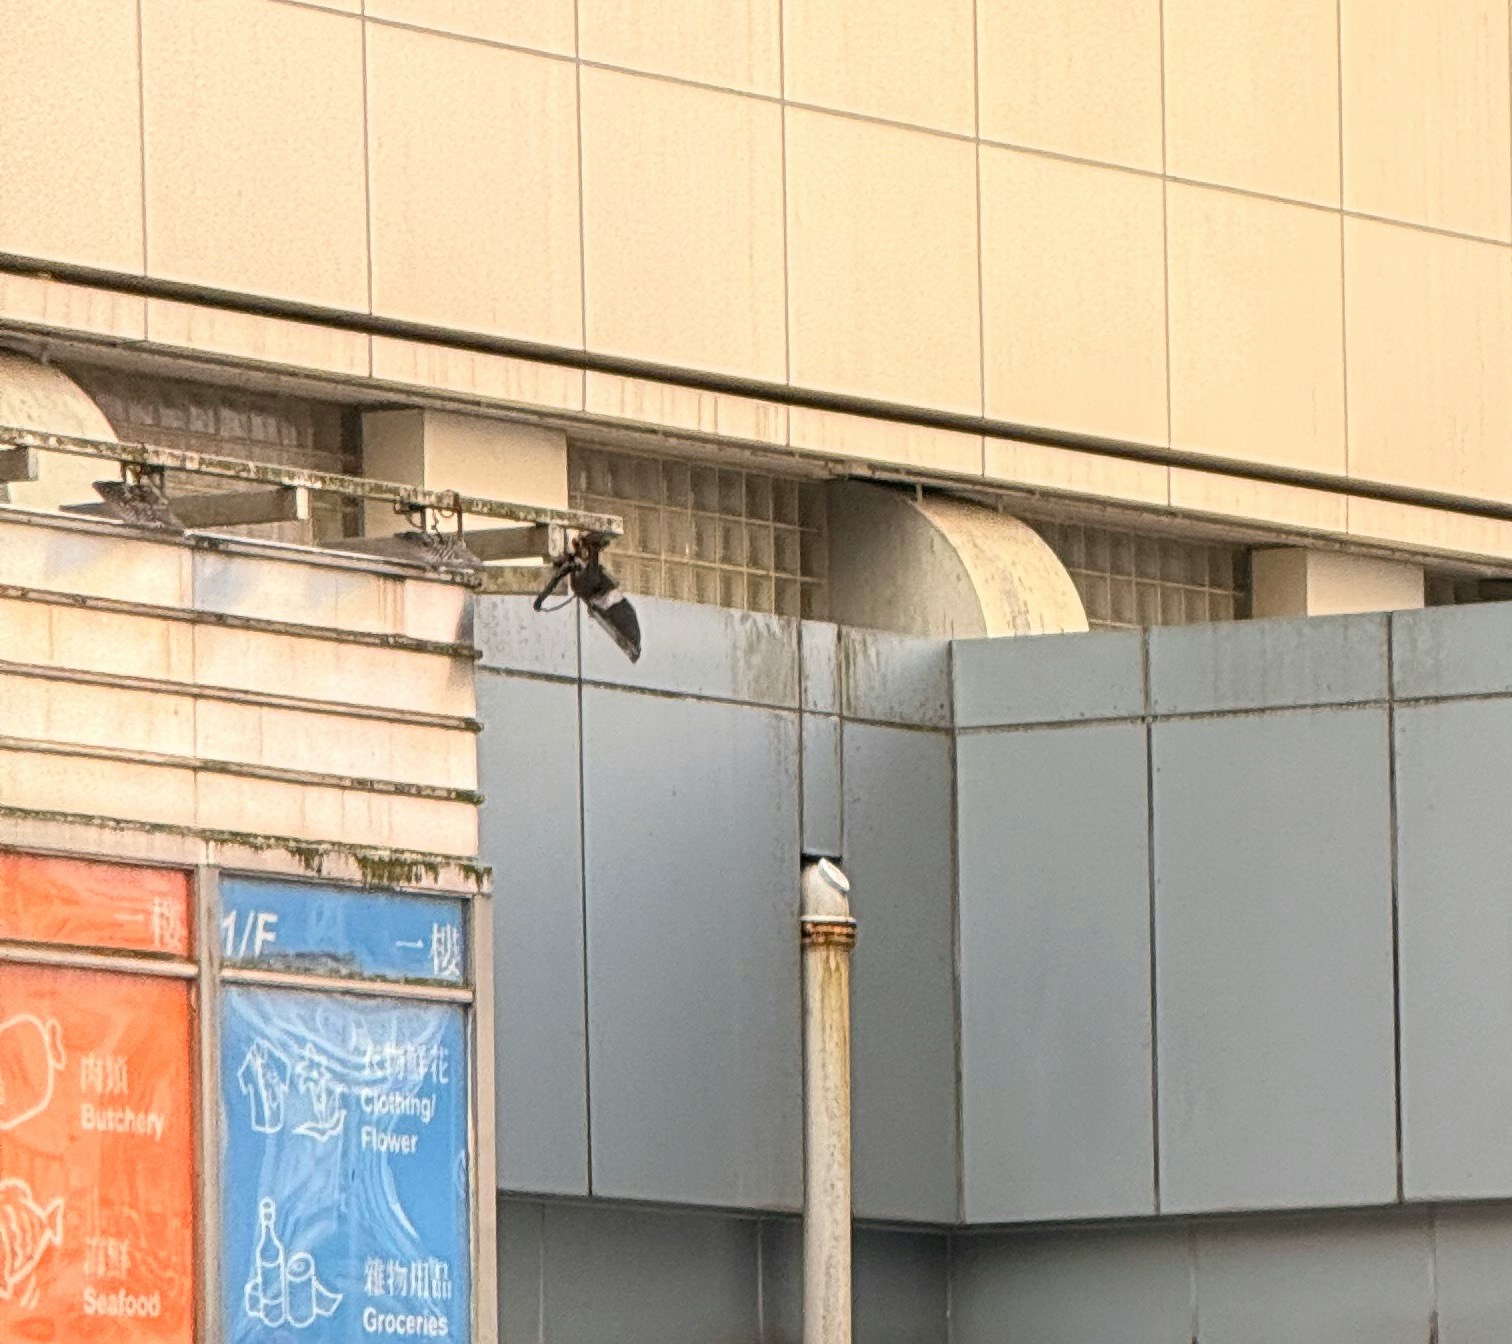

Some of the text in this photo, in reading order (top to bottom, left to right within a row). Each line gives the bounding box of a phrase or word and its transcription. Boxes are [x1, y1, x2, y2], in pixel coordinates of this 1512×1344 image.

[221, 909, 278, 960] 1/F
[395, 922, 460, 976] 一樓
[81, 1103, 165, 1142] Butchery
[361, 1087, 437, 1125] Clothing/
[361, 1125, 419, 1156] Flower
[83, 1286, 161, 1318] Seafood
[363, 1306, 449, 1337] Groceries
